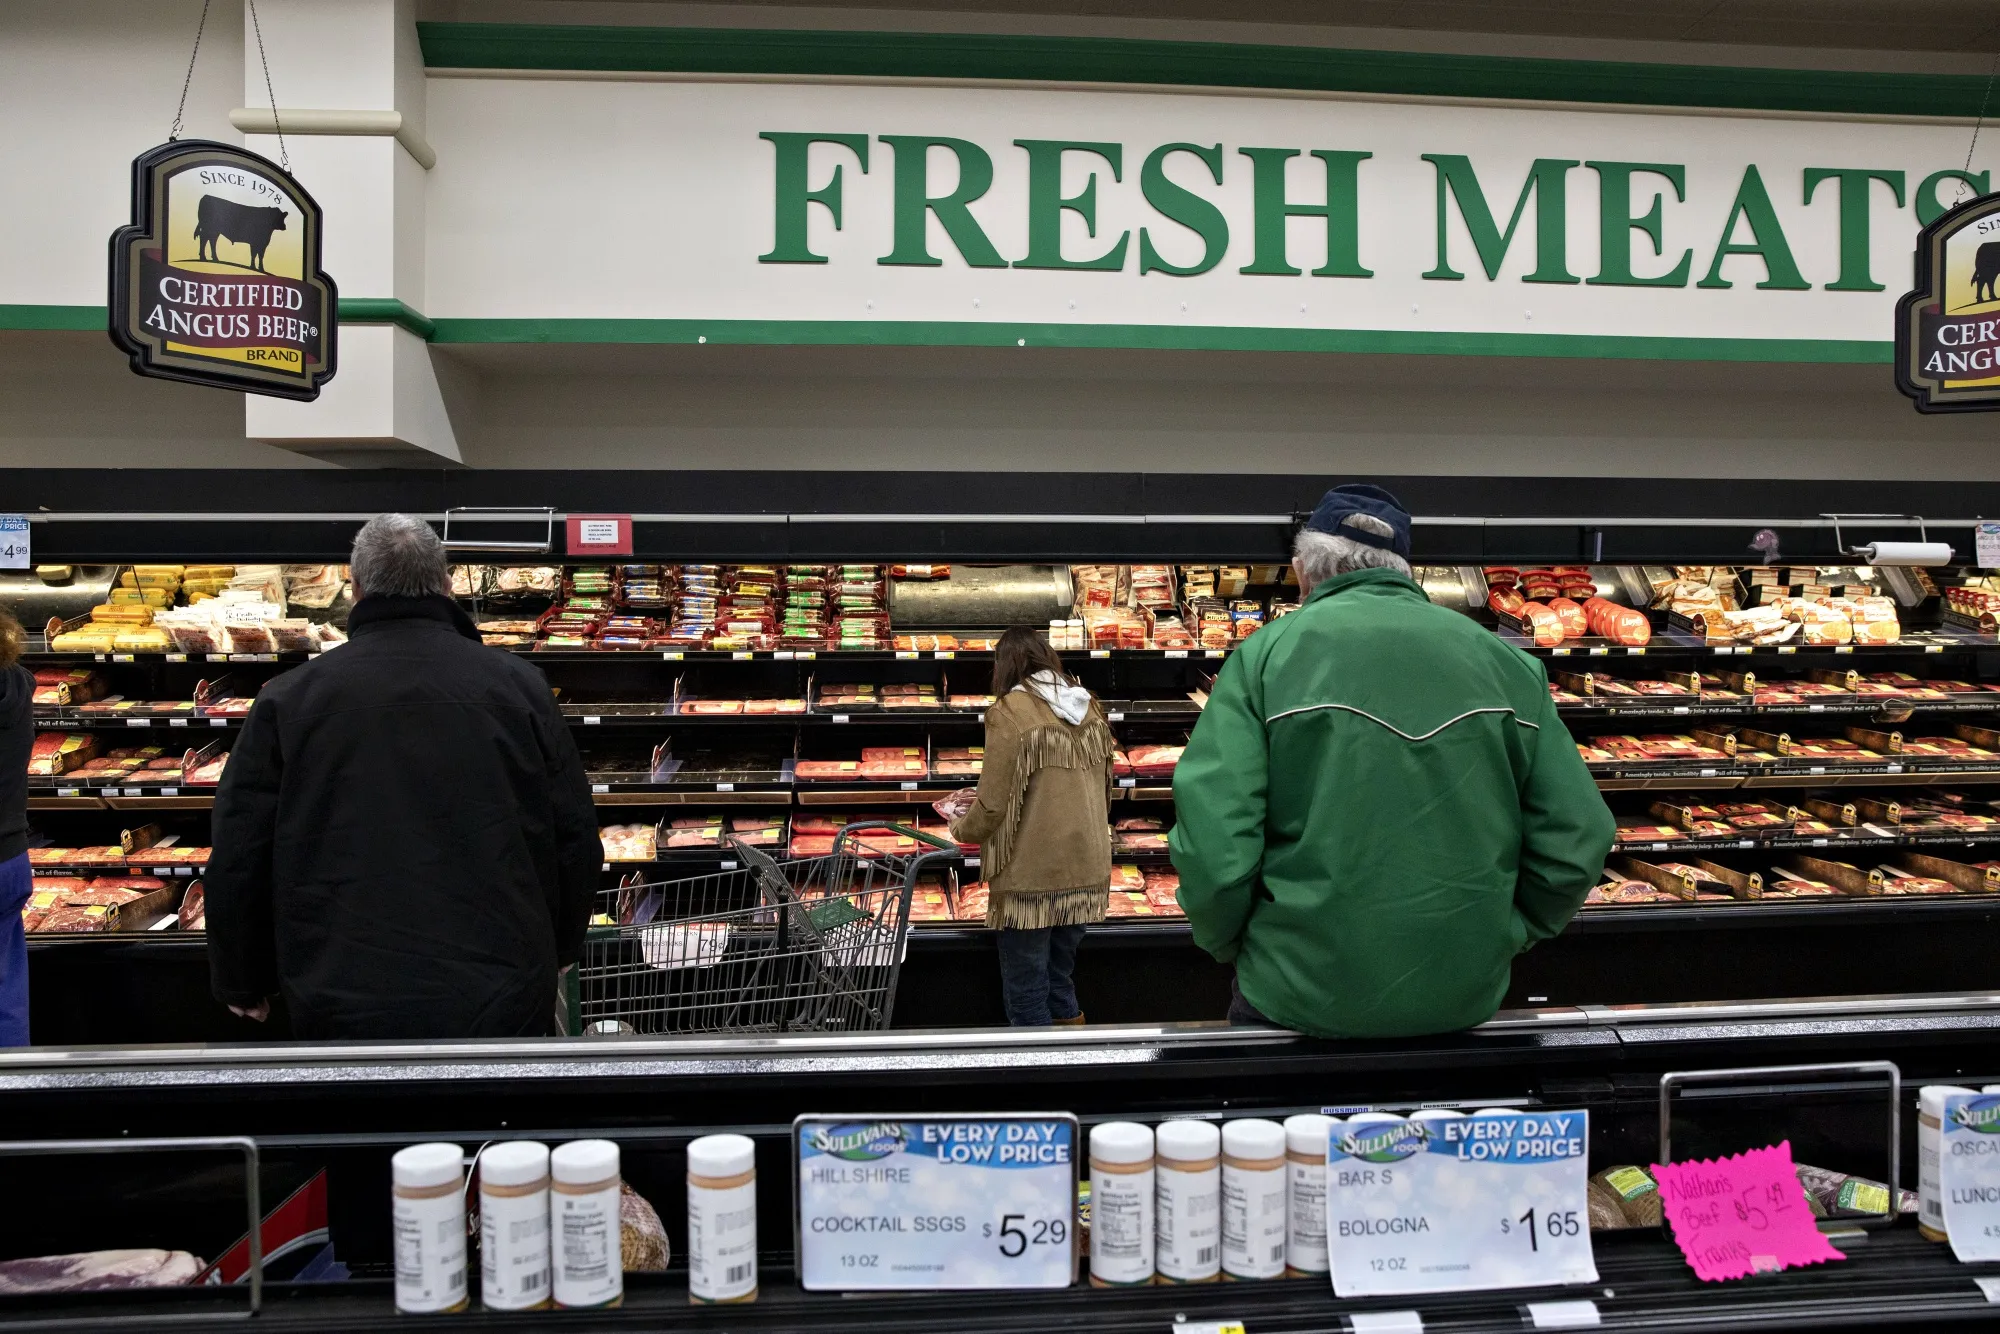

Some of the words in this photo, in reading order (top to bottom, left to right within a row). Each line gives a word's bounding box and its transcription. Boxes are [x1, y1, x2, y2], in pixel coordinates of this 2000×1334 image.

[251, 179, 283, 205] 1978
[759, 130, 1373, 280] FRESH
[159, 276, 303, 311] CERTIFIED
[145, 304, 250, 338] ANGUS
[246, 349, 299, 363] BRAND
[922, 1124, 1001, 1144] EVERY
[1005, 1124, 1058, 1143] DAY
[1444, 1120, 1518, 1142] EVERY
[1522, 1117, 1572, 1138] DAY
[937, 1144, 998, 1164] LOW
[1000, 1143, 1070, 1164] PRICE
[1458, 1140, 1514, 1161] LOW
[1516, 1137, 1582, 1158] PRICE
[1951, 1141, 2000, 1157] OSCA
[811, 1168, 911, 1184] HILLSHIRE
[1338, 1170, 1375, 1187] BAR
[1381, 1169, 1393, 1185] S
[1669, 1171, 1734, 1201] Nathan's
[1952, 1188, 2000, 1204] LUNC
[811, 1216, 907, 1233] COCKTAIL
[913, 1216, 966, 1233] SSGS
[1339, 1216, 1430, 1237] BOLOGNA
[1681, 1202, 1720, 1230] Beef
[841, 1255, 856, 1267] 13
[859, 1255, 879, 1267] OZ
[1688, 1233, 1752, 1272] Franks
[1370, 1260, 1384, 1272] 12
[1388, 1258, 1407, 1271] OZ
